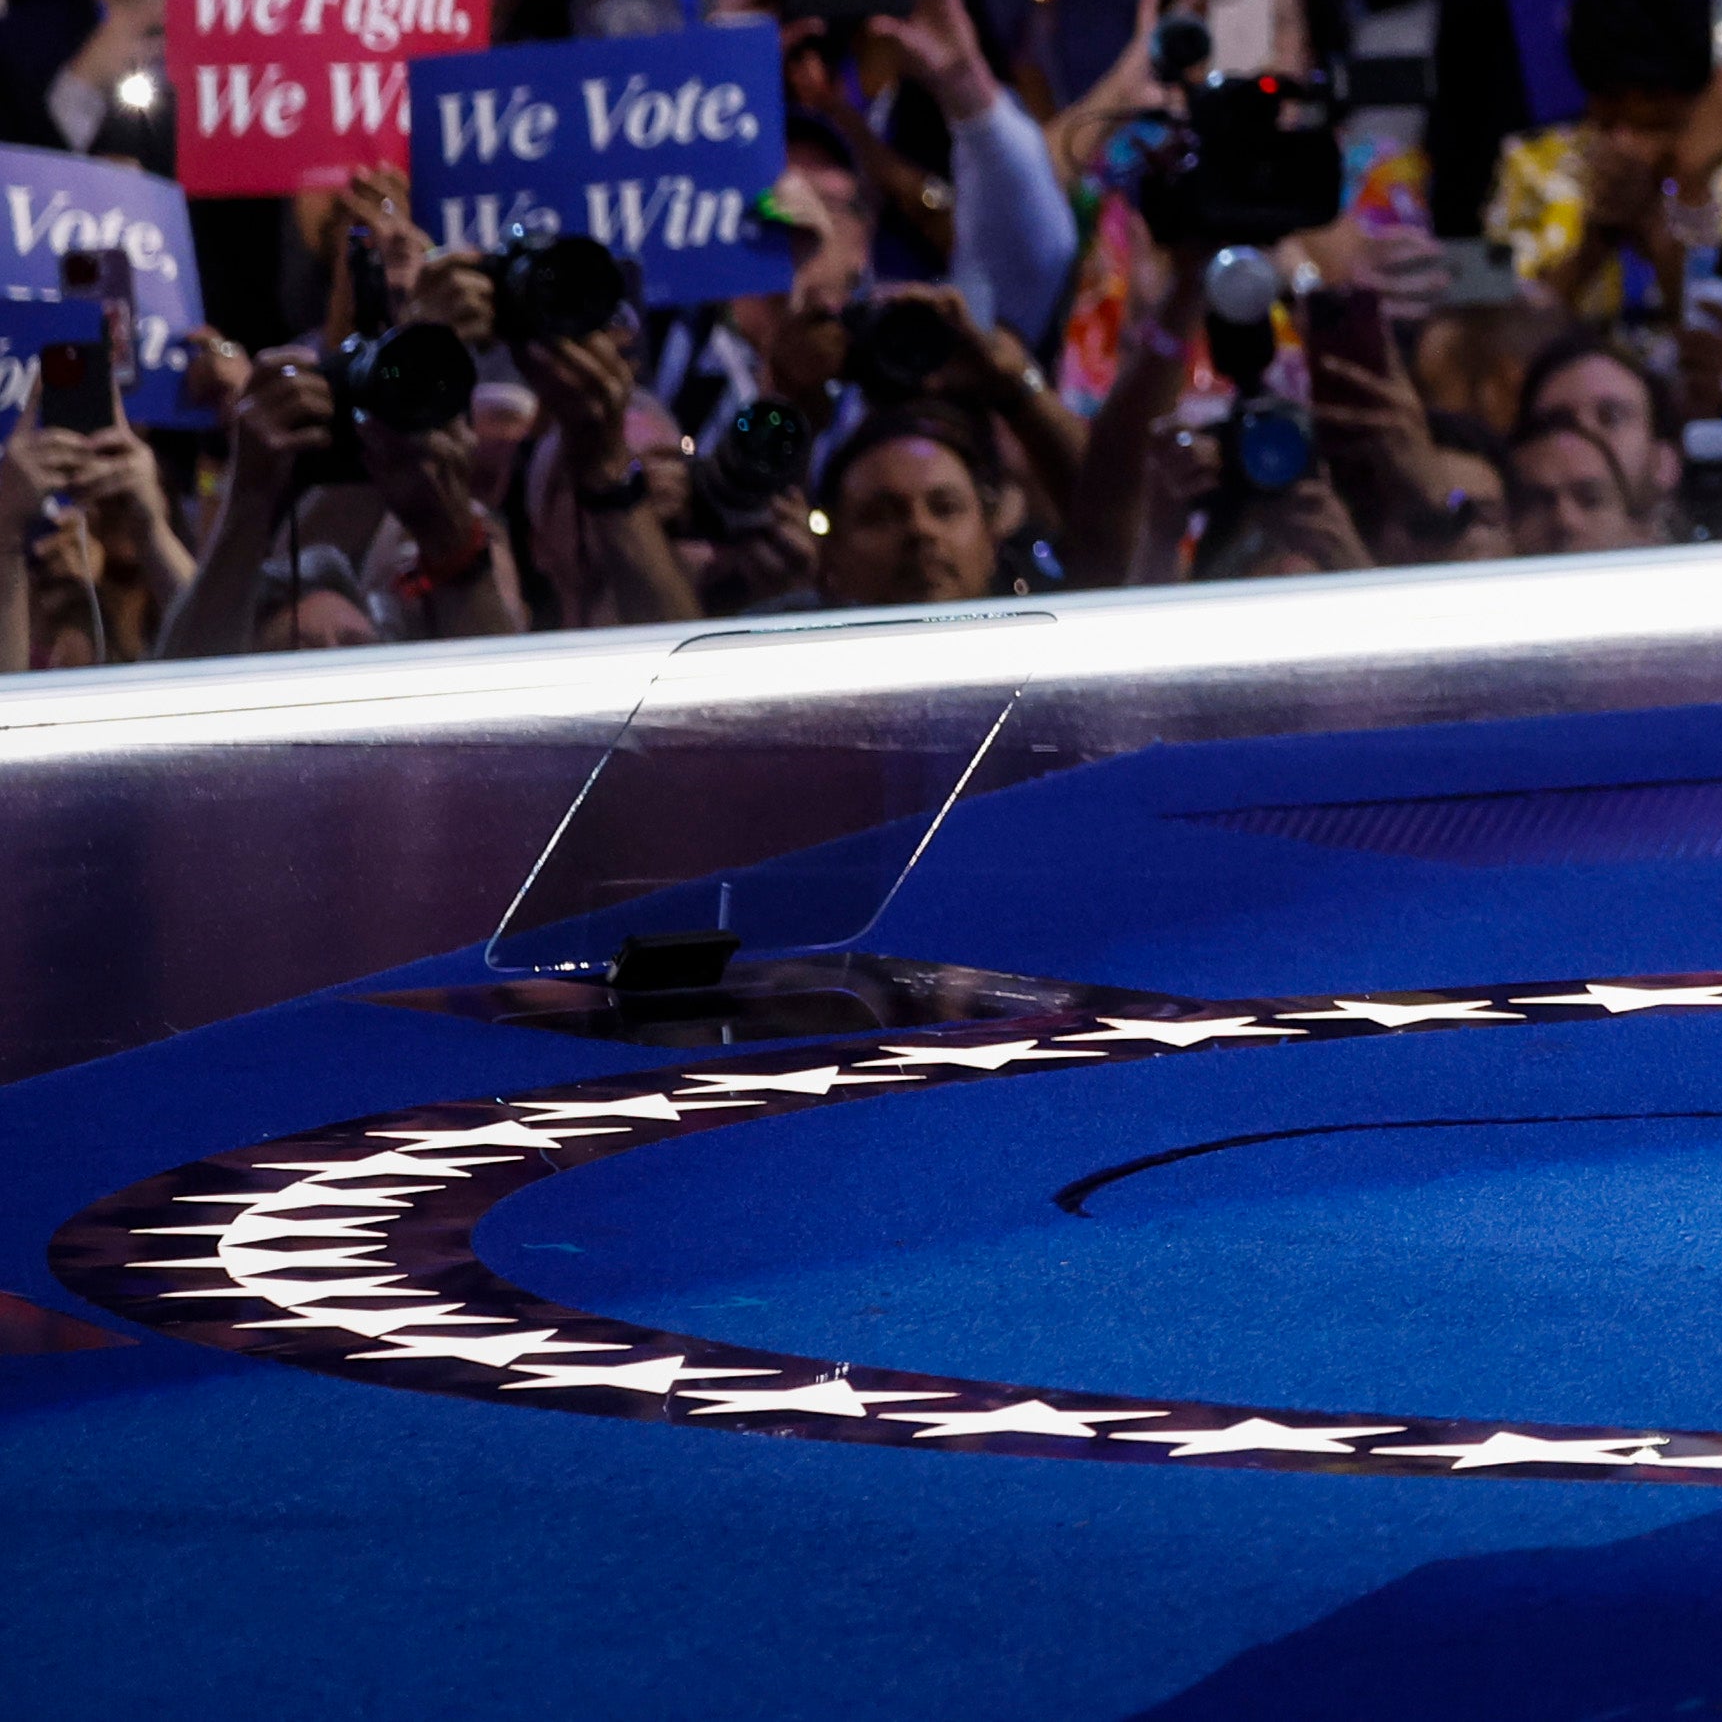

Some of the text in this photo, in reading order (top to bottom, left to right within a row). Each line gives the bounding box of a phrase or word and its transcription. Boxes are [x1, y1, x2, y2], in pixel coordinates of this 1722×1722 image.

[196, 62, 307, 139] We
[437, 73, 759, 166] We Vote,
